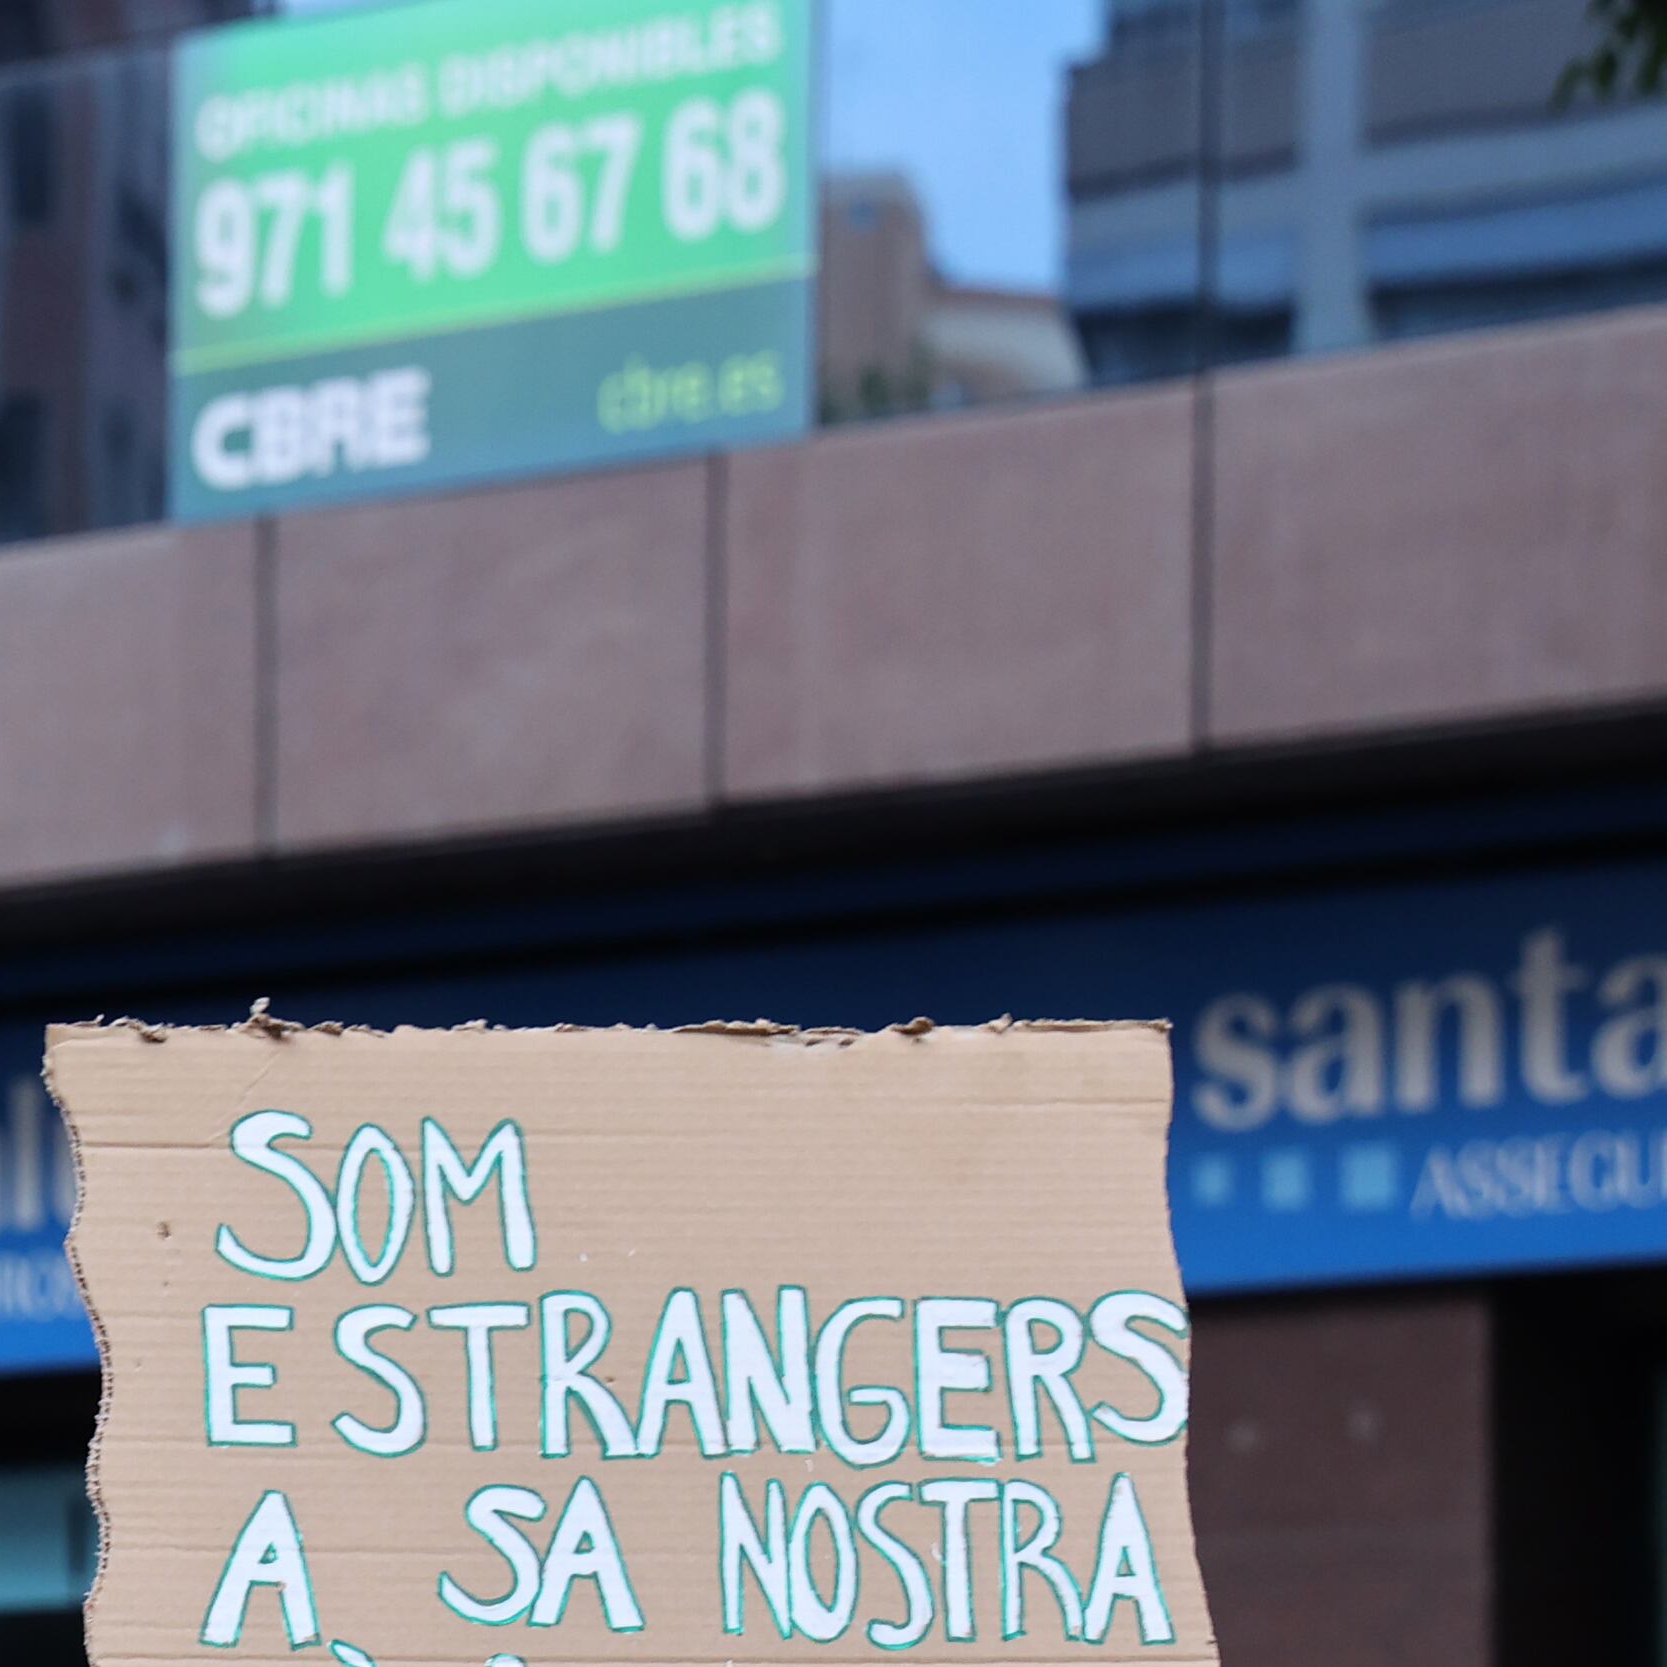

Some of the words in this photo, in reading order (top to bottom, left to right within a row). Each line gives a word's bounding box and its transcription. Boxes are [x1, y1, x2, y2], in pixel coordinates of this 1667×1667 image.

[193, 61, 430, 161] OFICINAS
[439, 6, 782, 117] DISPONIBLES
[193, 159, 354, 318] 971
[384, 136, 499, 281] 45
[521, 111, 641, 264] 67
[662, 87, 785, 241] 68
[192, 364, 432, 489] CBRE
[597, 350, 784, 435] cbre.es
[215, 1109, 537, 1285] SOM
[202, 1284, 1190, 1469] ESTRANGERS
[199, 1490, 322, 1651] A
[438, 1476, 645, 1633] SA
[719, 1472, 1176, 1651] NOSTRA
